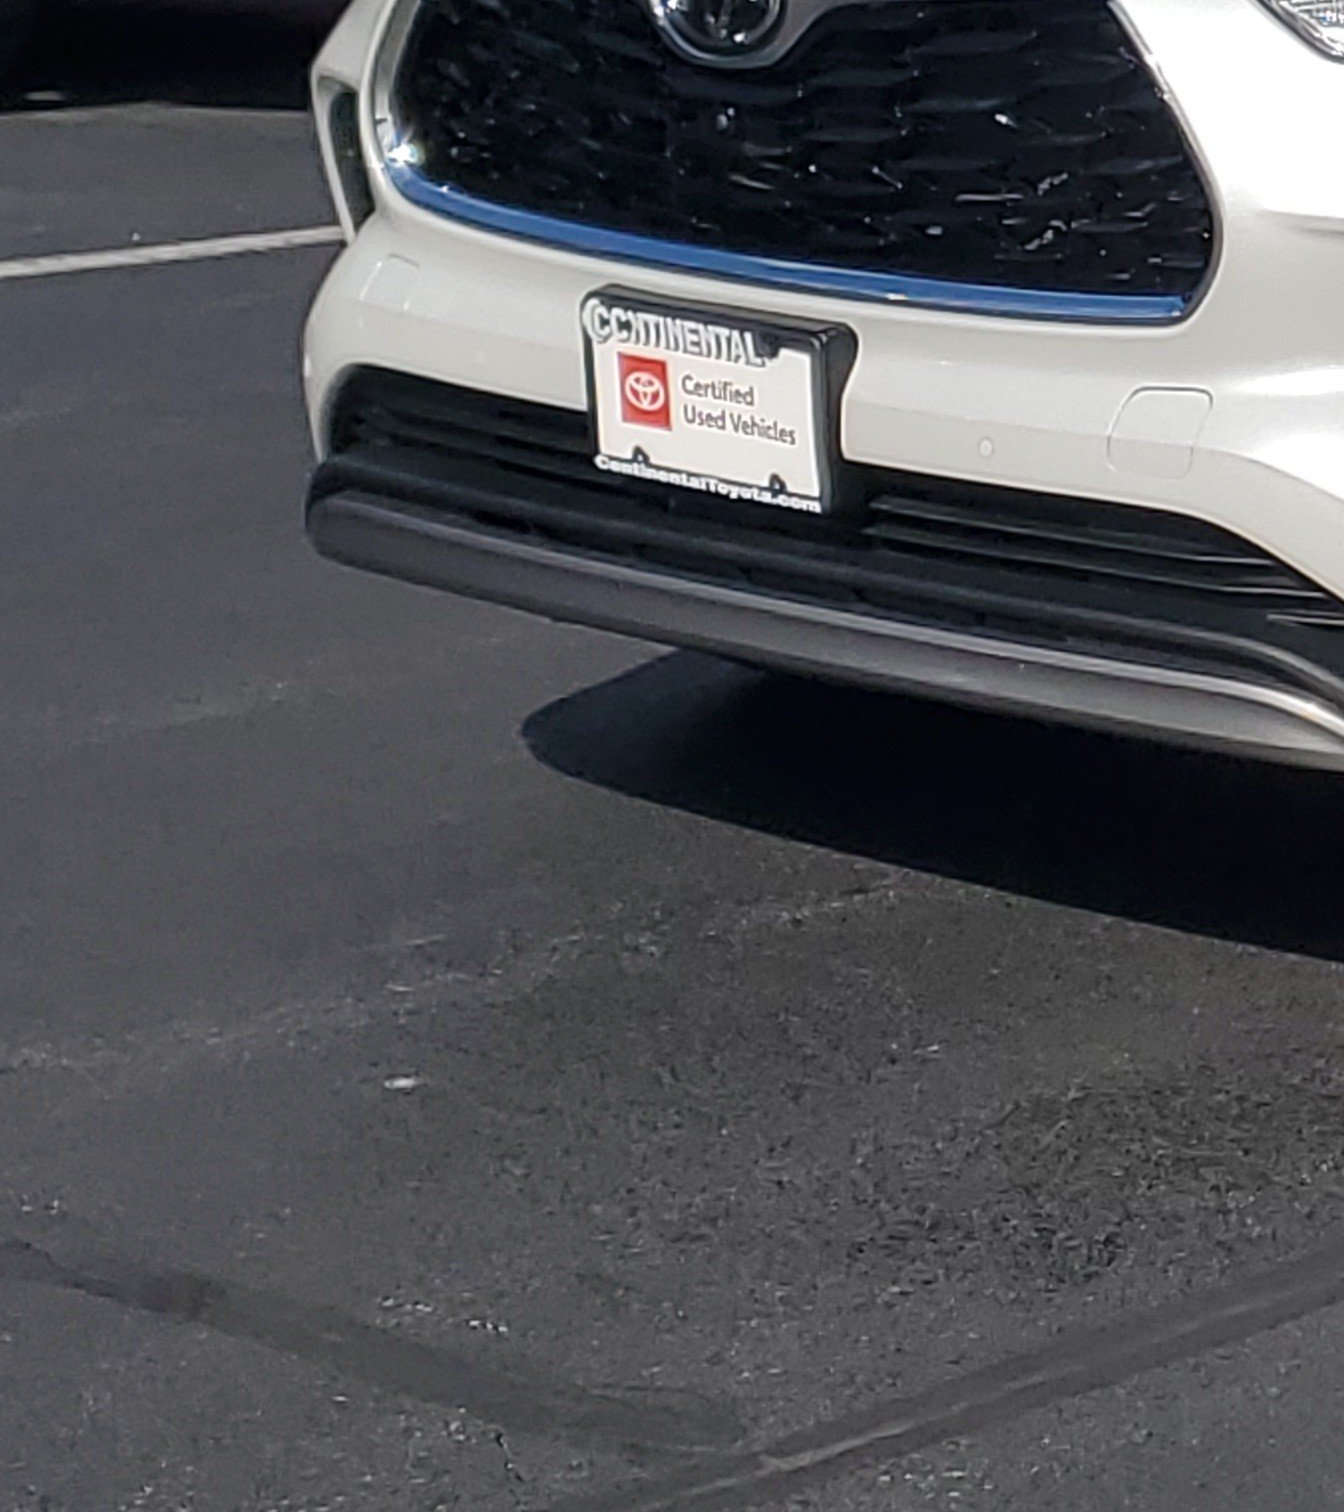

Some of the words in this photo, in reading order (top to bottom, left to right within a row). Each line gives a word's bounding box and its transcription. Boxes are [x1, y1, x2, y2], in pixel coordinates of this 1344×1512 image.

[681, 374, 754, 406] Certified
[683, 404, 726, 430] Used
[728, 412, 796, 445] Vehicles
